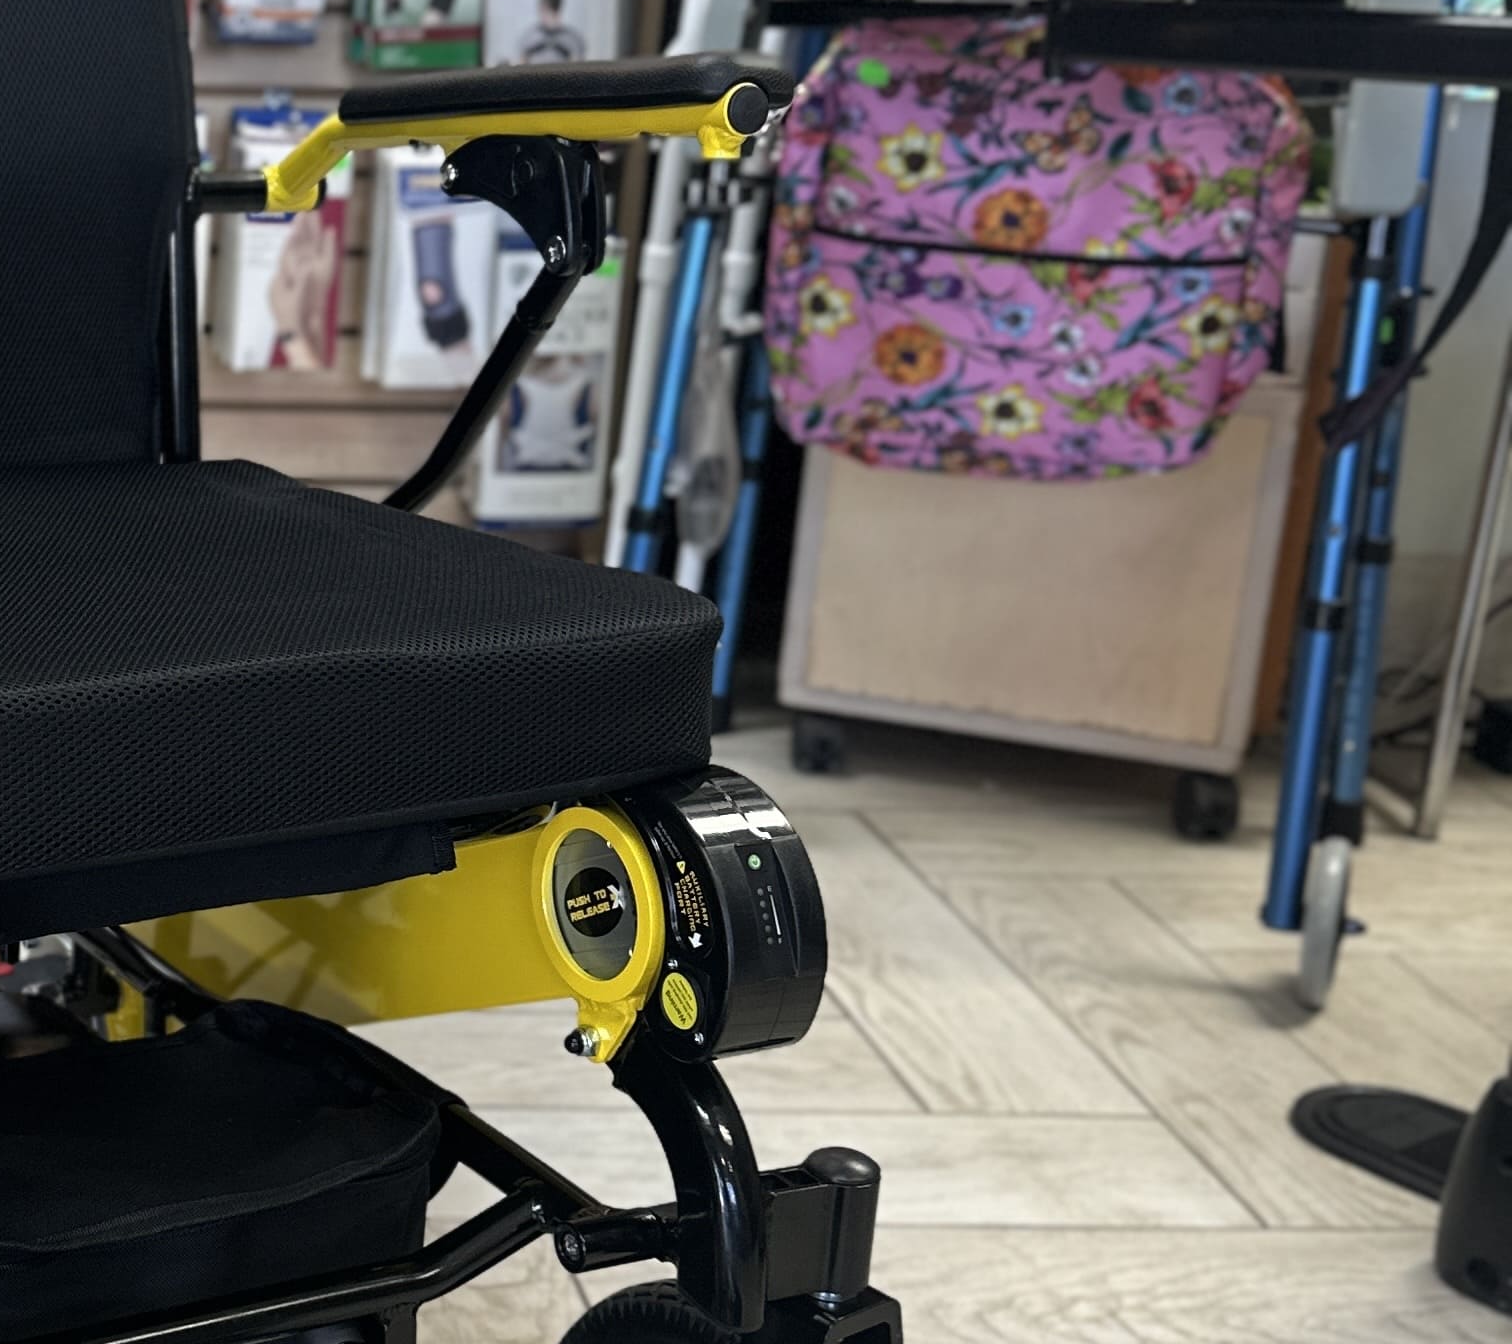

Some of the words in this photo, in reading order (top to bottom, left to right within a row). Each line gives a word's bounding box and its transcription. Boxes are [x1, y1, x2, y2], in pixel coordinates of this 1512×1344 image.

[567, 894, 591, 910] PUSH
[593, 888, 607, 901] TO
[570, 902, 610, 922] RELEASE
[674, 882, 686, 915] PORT
[680, 878, 697, 932] CHARGING
[685, 875, 701, 924] BATTERY
